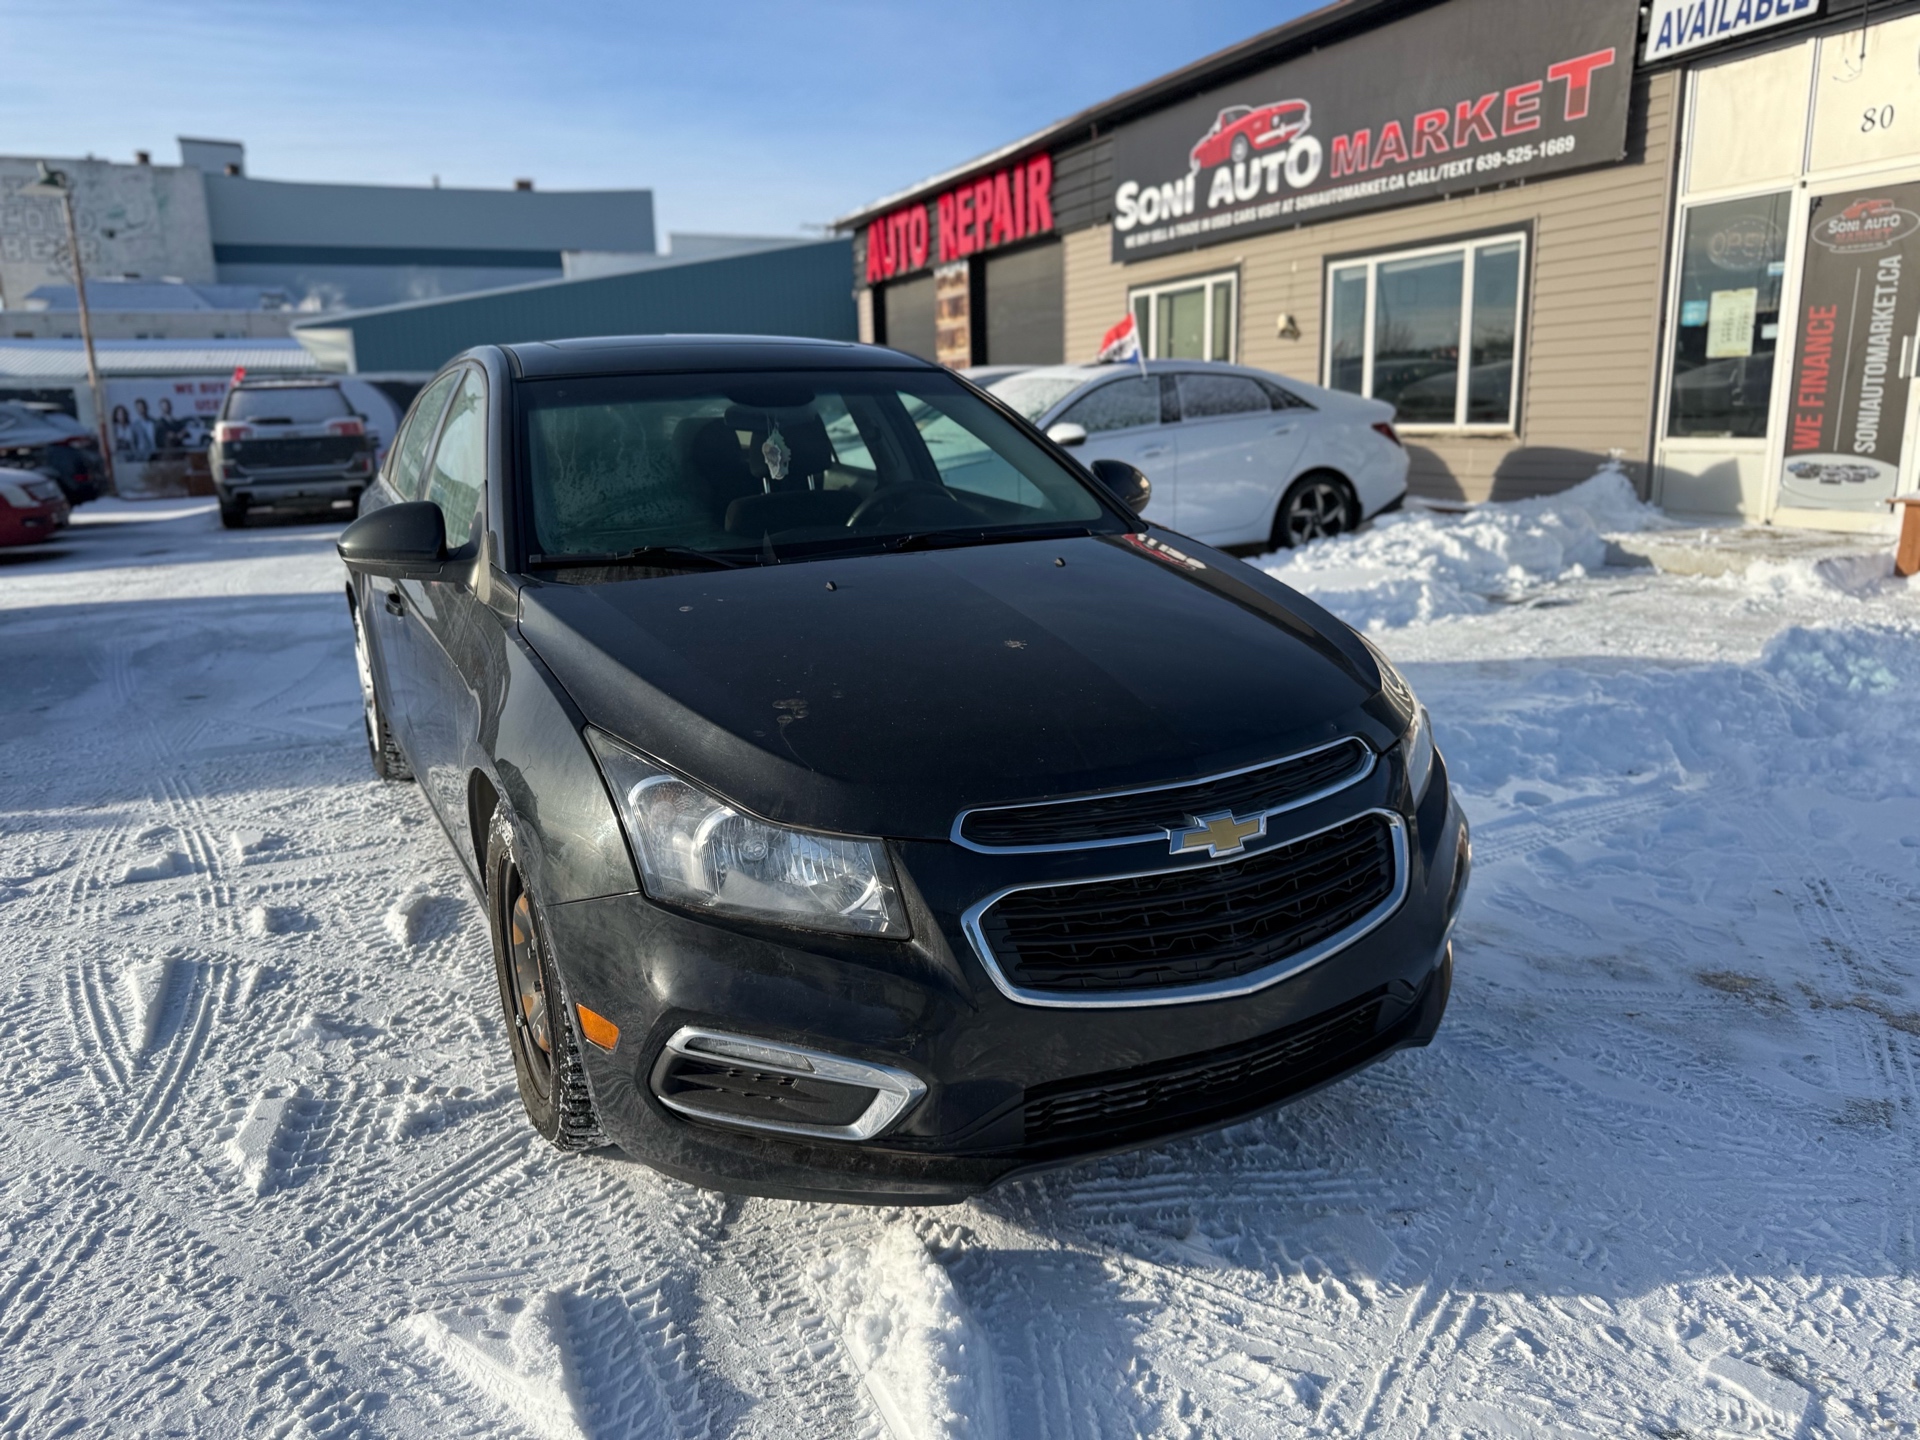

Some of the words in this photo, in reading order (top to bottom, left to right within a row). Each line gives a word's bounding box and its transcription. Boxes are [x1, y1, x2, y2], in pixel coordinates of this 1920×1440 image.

[1655, 0, 1810, 52] AVAILAB
[1115, 173, 1196, 231] SONI
[1207, 135, 1323, 209] AUTO
[1330, 47, 1616, 178] MARKET
[1861, 104, 1894, 132] 80
[1295, 173, 1405, 212] SONIAUTOMARKET.CA
[1407, 157, 1474, 187] CALL/TEXT
[1475, 134, 1576, 172] 639-525-1669
[866, 204, 930, 283] AUTO
[937, 151, 1054, 263] REPAIR
[1828, 219, 1860, 234] SONI
[1864, 214, 1901, 230] AUTO
[1797, 304, 1837, 407] FINANCE
[1853, 254, 1902, 453] SONIAUTOMARKET.CA
[1792, 413, 1823, 450] WE
